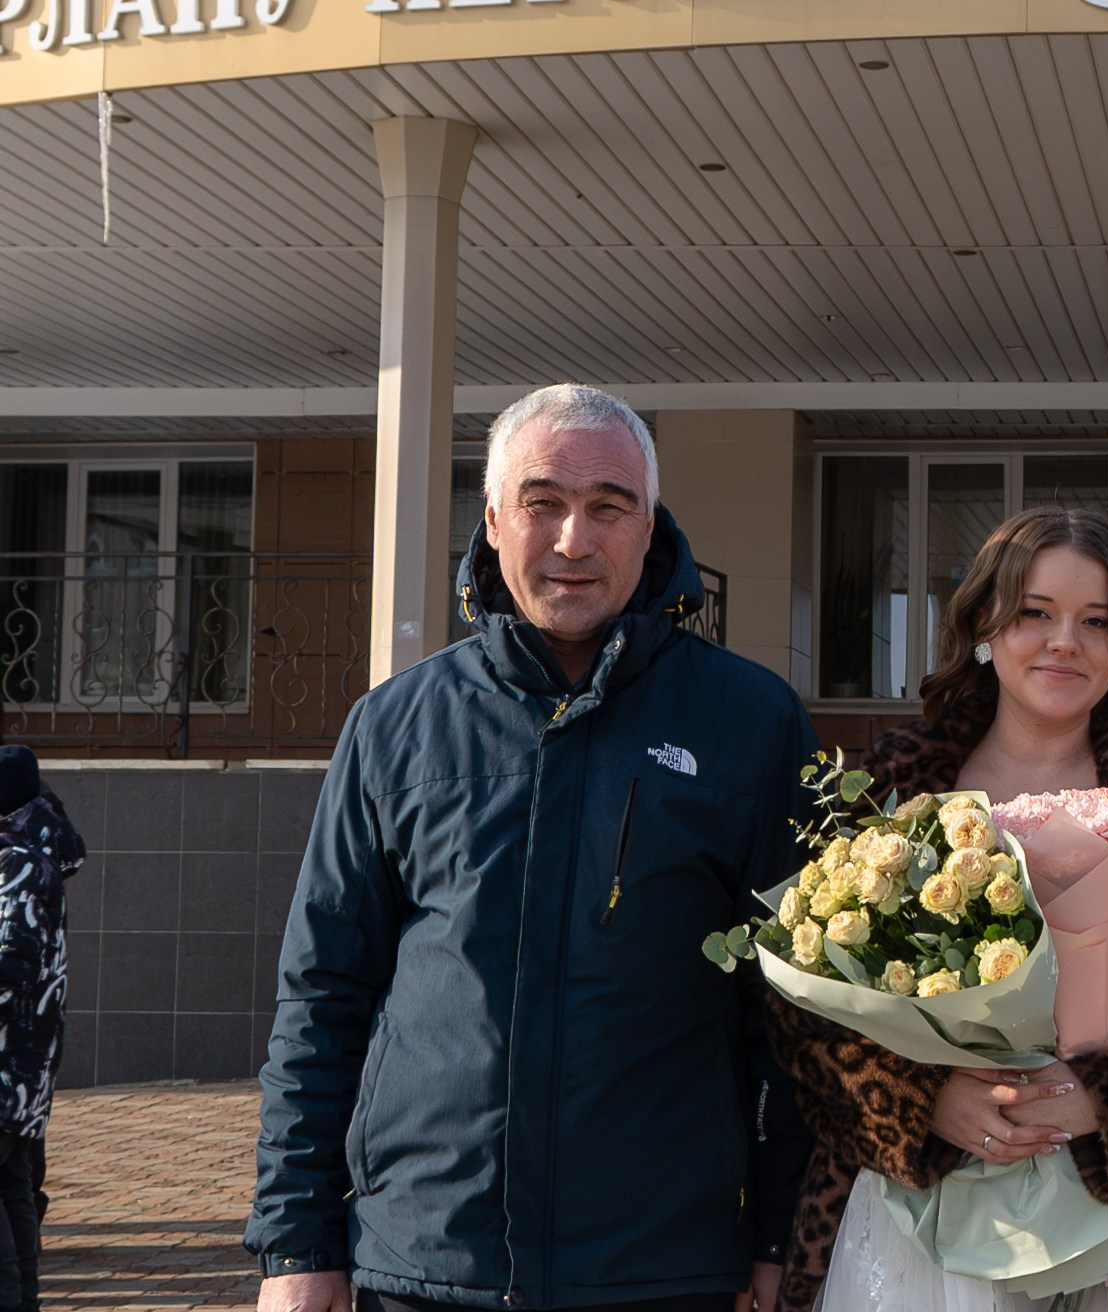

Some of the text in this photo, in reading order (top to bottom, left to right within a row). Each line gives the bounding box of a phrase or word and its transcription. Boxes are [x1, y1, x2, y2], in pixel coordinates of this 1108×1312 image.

[647, 747, 681, 763] NORTH
[663, 742, 682, 755] THE
[656, 756, 681, 771] FACE
